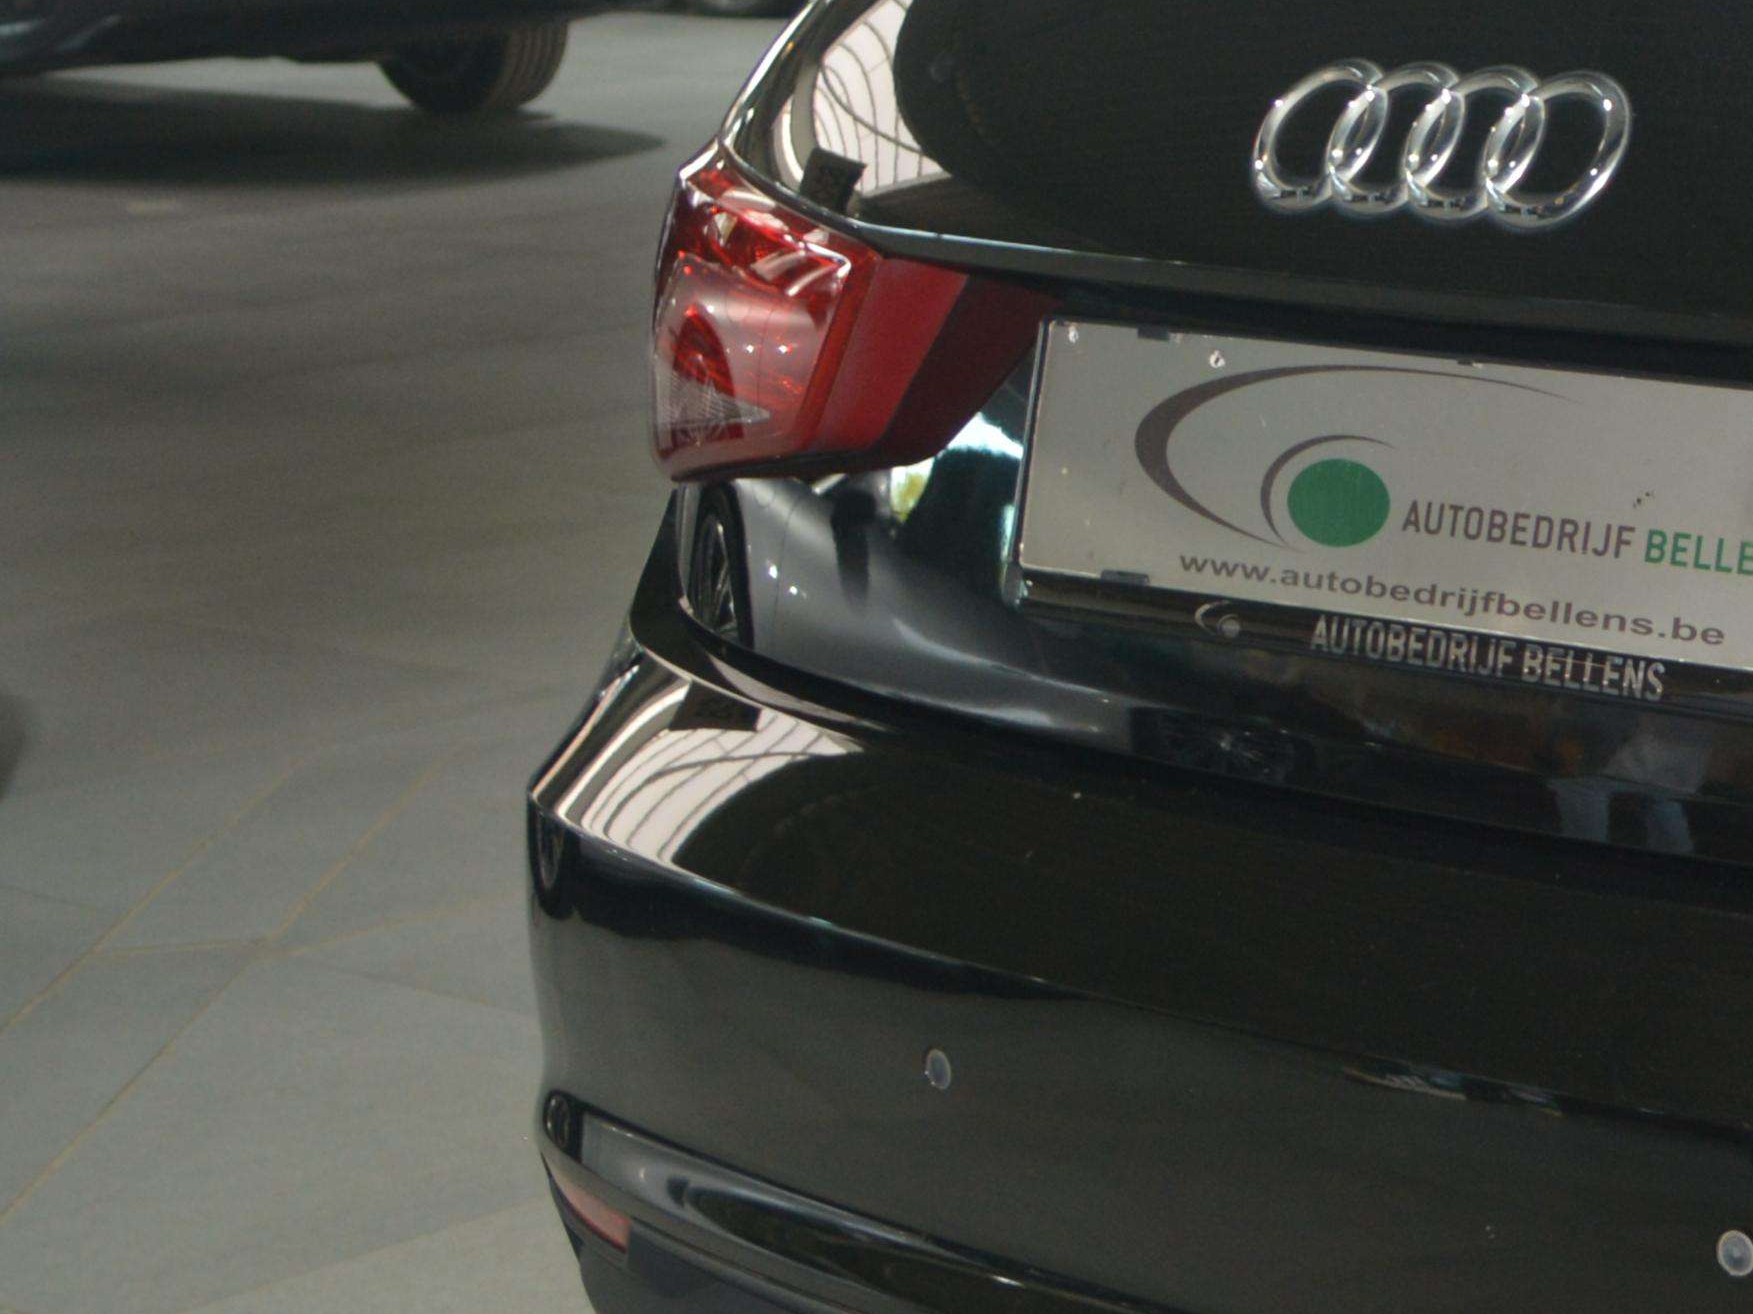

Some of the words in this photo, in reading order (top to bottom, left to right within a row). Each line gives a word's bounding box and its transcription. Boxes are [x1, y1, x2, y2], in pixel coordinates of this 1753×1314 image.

[1402, 500, 1635, 560] AUTOBEDRIJF
[1179, 553, 1727, 646] www.autobedrijfbellens.be
[1310, 613, 1515, 677] AUTOBEDRIJF
[1521, 642, 1666, 703] BELLENS
